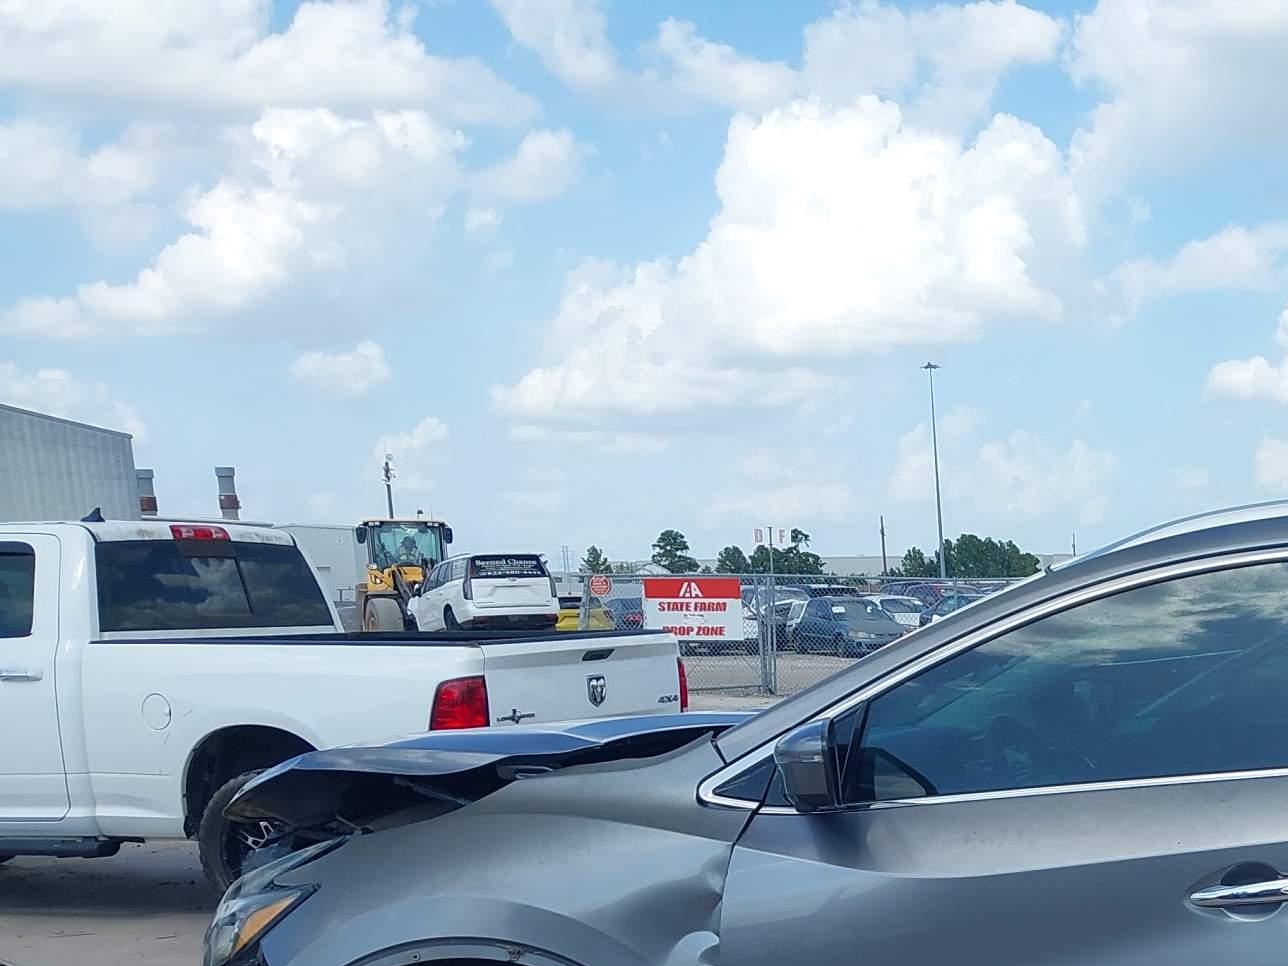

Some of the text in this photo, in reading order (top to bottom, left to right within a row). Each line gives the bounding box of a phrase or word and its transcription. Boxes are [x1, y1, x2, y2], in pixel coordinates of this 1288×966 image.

[754, 529, 763, 543] D
[778, 529, 785, 543] F
[658, 602, 727, 612] STATE FARM
[696, 626, 726, 636] ZONE
